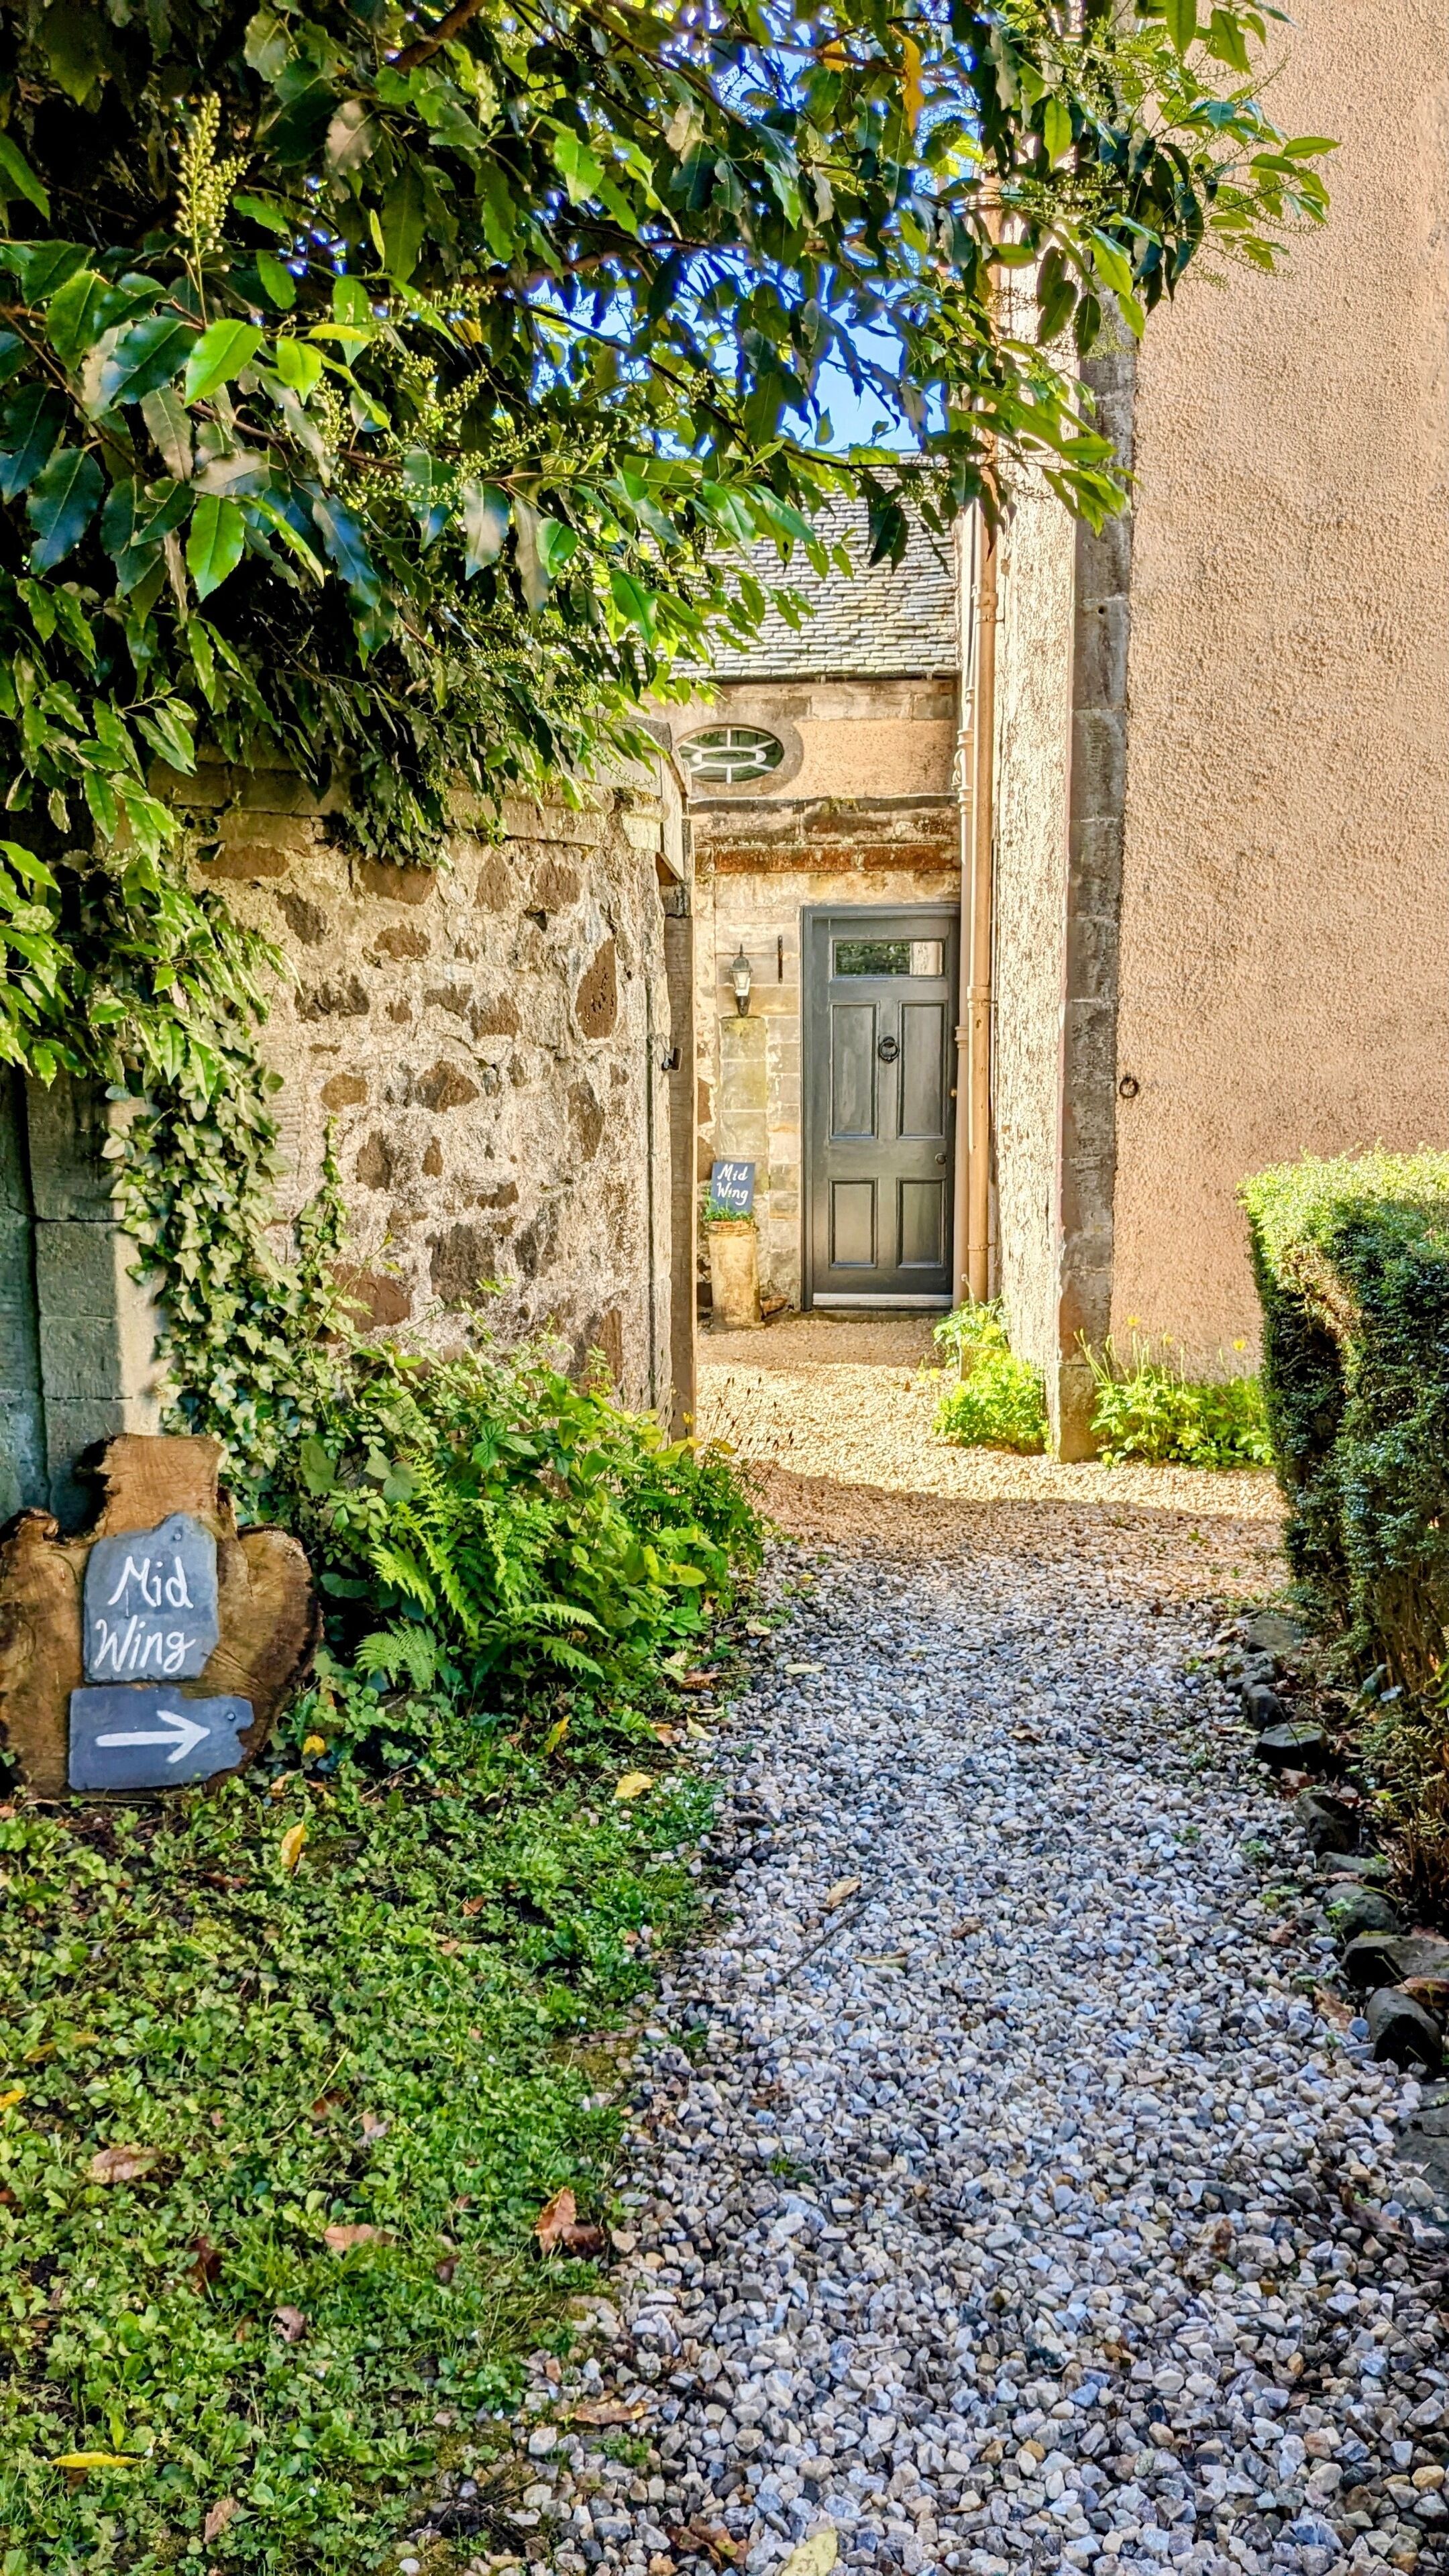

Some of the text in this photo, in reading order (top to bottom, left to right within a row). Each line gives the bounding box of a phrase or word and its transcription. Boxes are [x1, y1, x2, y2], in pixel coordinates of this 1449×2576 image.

[716, 1163, 749, 1181] Mid
[716, 1182, 749, 1205] Wing
[107, 1556, 194, 1608] Mid
[94, 1615, 196, 1673] Wing
